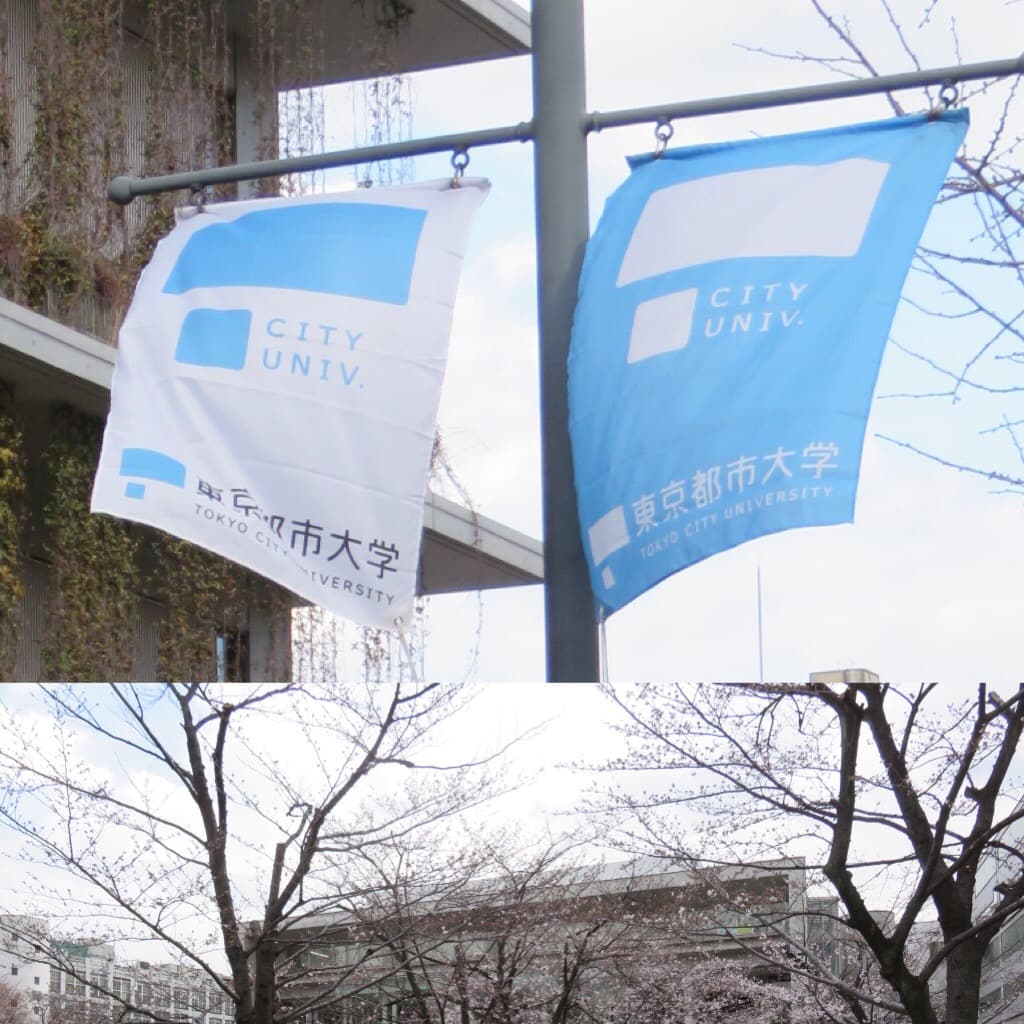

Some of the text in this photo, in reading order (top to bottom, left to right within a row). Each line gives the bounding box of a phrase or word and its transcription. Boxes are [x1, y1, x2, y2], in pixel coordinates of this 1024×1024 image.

[710, 281, 808, 308] CITY
[266, 318, 363, 351] CITY
[704, 309, 804, 337] UNIV.
[262, 347, 364, 389] UNIV.
[631, 442, 839, 537] 東京都市大学
[640, 486, 833, 560] TOKYO CITY UNIVERSITY
[195, 503, 249, 534] TOKYO
[296, 563, 396, 606] IVERSITY
